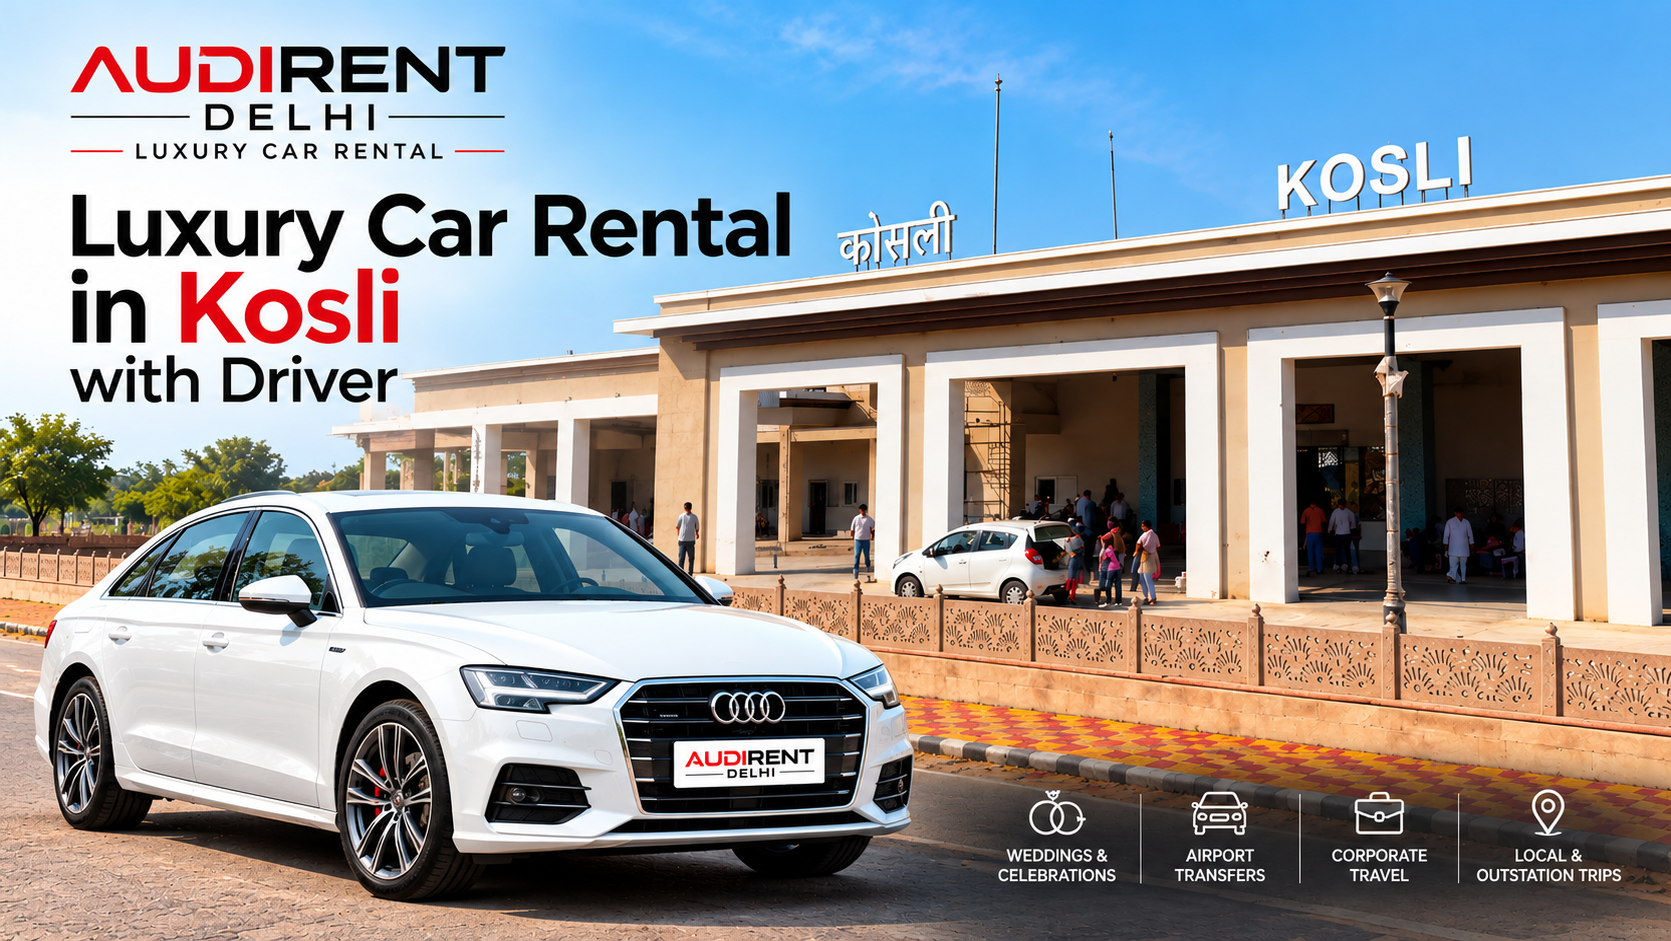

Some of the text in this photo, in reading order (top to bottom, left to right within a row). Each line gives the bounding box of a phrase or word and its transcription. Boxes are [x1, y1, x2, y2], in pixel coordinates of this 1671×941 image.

[1278, 136, 1472, 210] KOSLI
[837, 200, 957, 265] कोसली
[685, 749, 815, 768] AUDIRENT
[727, 768, 775, 779] DELHI
